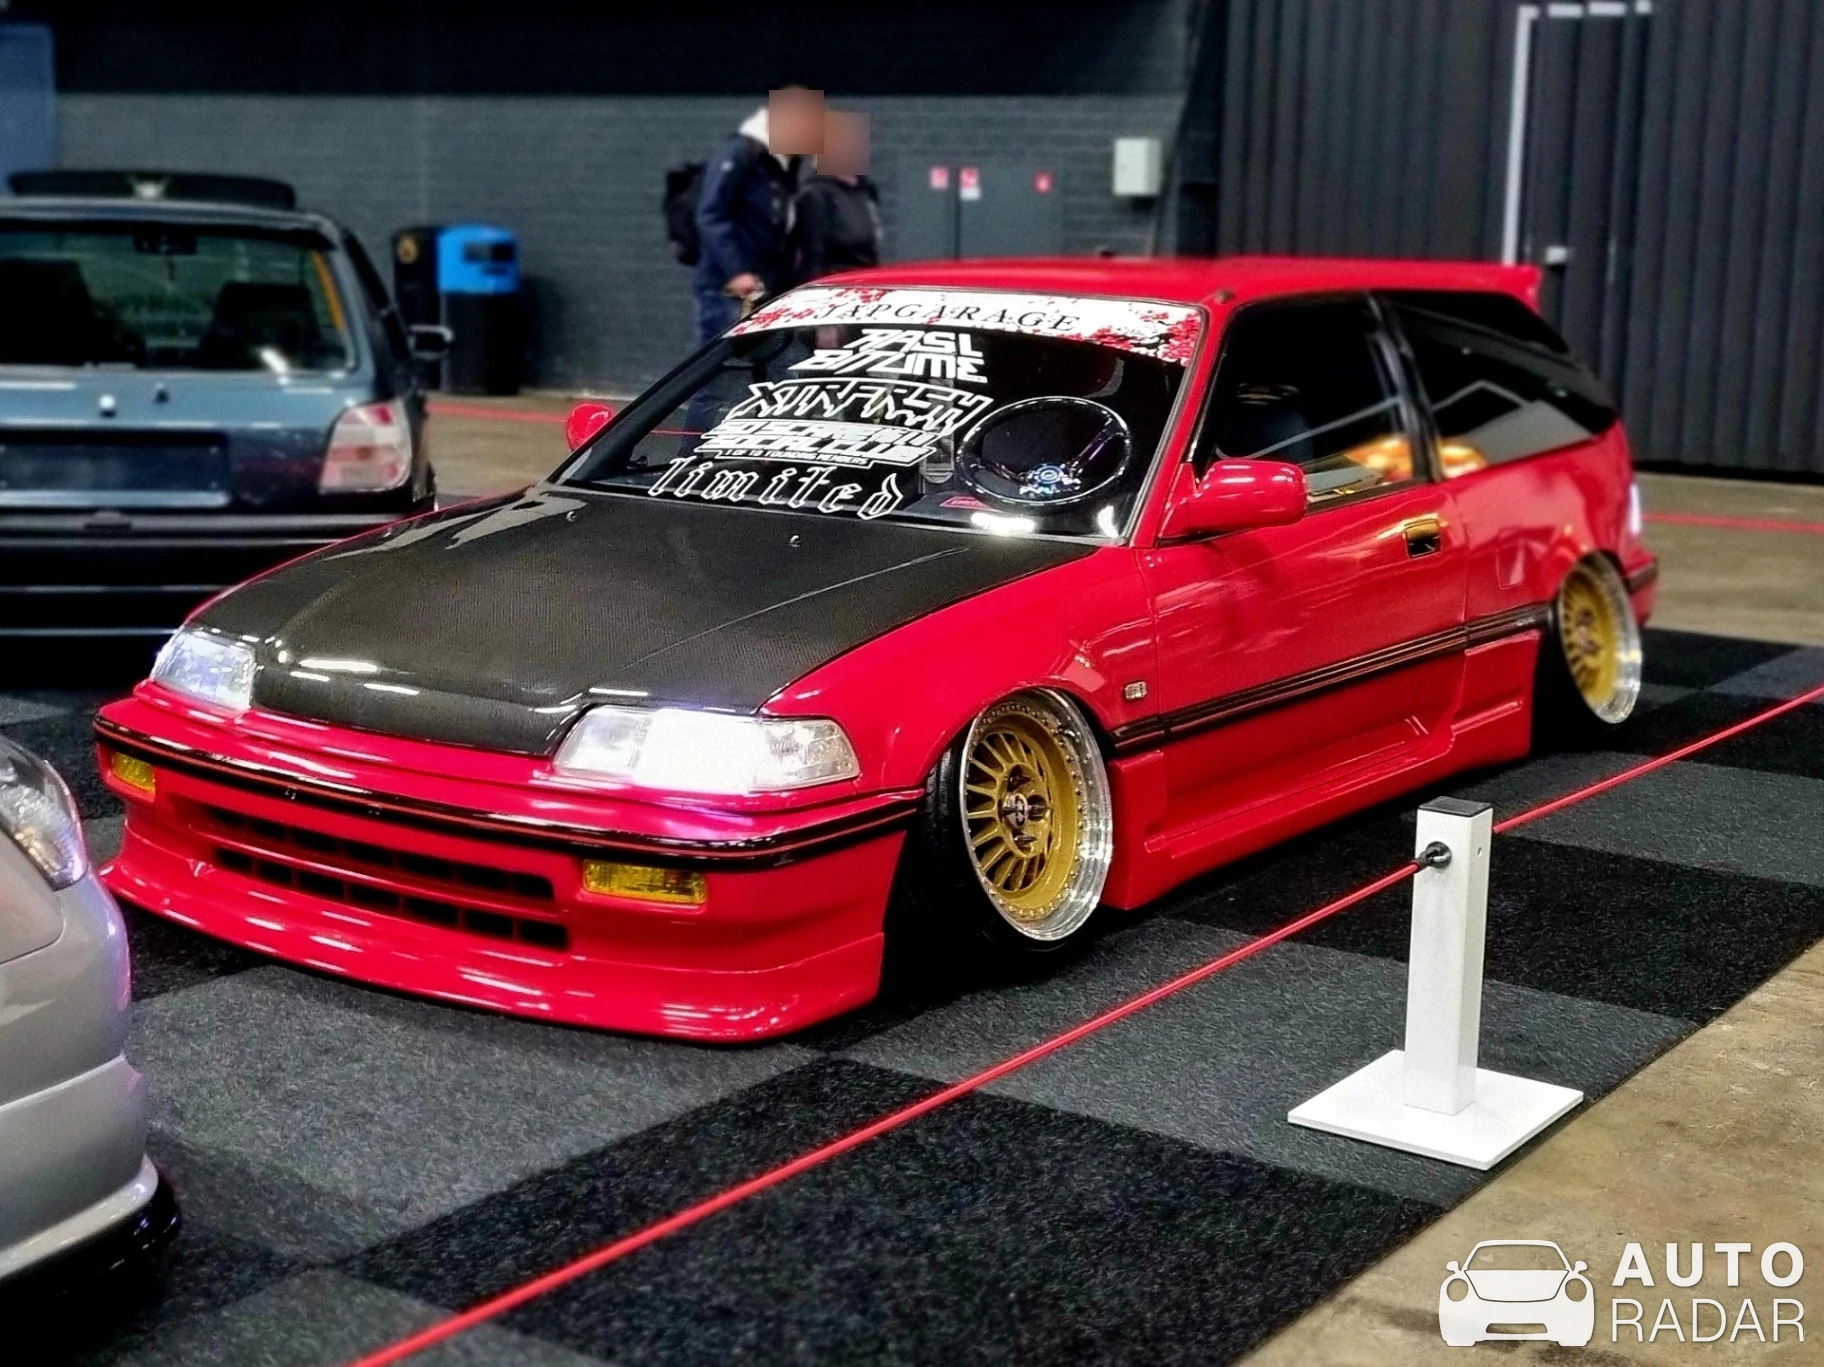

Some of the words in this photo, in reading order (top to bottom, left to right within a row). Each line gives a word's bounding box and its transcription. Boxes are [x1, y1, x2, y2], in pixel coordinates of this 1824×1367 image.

[814, 302, 1080, 331] JAPGARAGE
[699, 434, 824, 453] SOCIAL
[816, 438, 931, 462] CLUB
